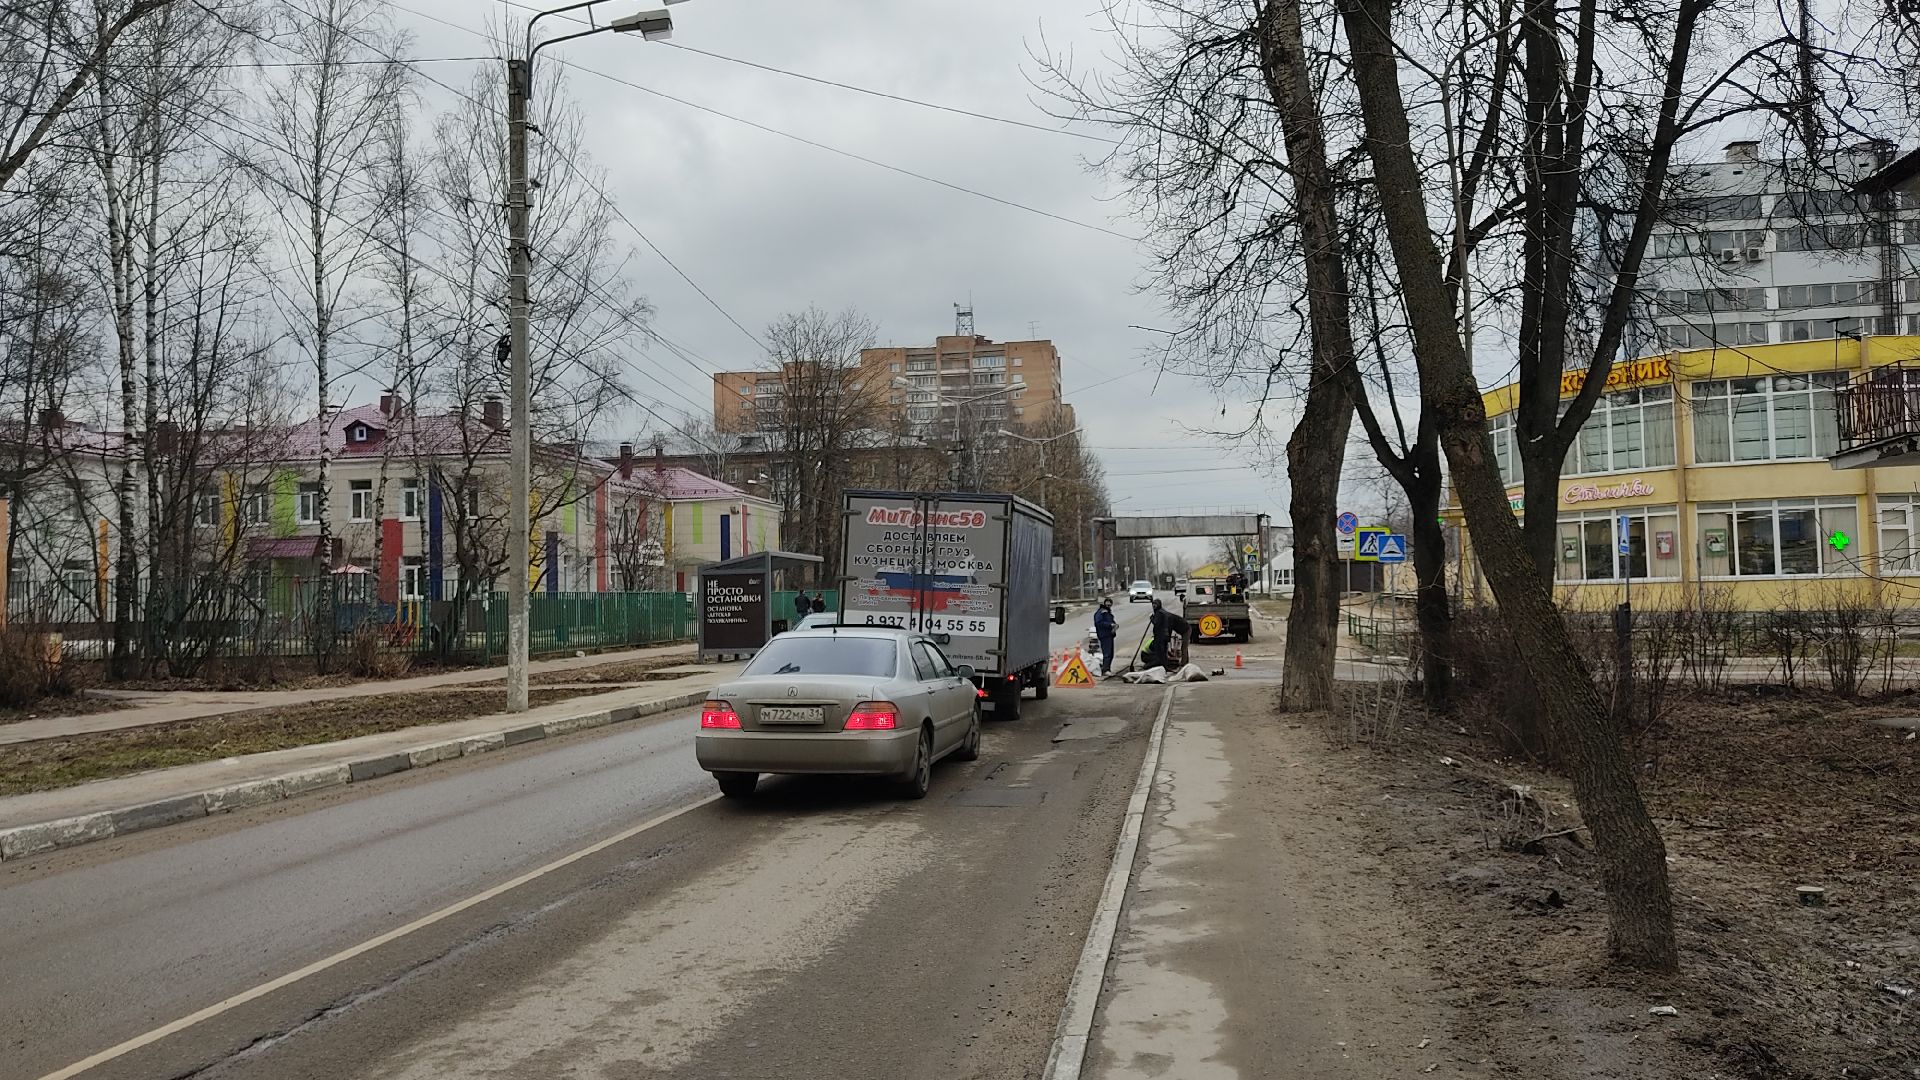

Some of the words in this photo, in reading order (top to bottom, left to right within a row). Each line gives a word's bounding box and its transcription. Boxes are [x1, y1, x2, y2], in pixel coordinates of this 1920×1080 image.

[1564, 479, 1654, 504] Столички
[868, 507, 985, 528] МиТранс58
[883, 531, 966, 542] ДОСТАВЛЯЕМ
[866, 543, 935, 555] СБОРНЫЙ
[939, 547, 971, 557] ГРУЗ
[854, 556, 915, 567] КУЗНЕЦК
[937, 560, 993, 571] МОСКВА
[707, 579, 719, 588] НЕ
[707, 587, 744, 596] ПРОСТО
[707, 594, 762, 604] ОСТАНОВКИ
[866, 615, 874, 625] 8
[879, 616, 904, 627] 937
[947, 620, 964, 631] 55
[968, 621, 987, 633] 55
[1204, 620, 1217, 630] 20
